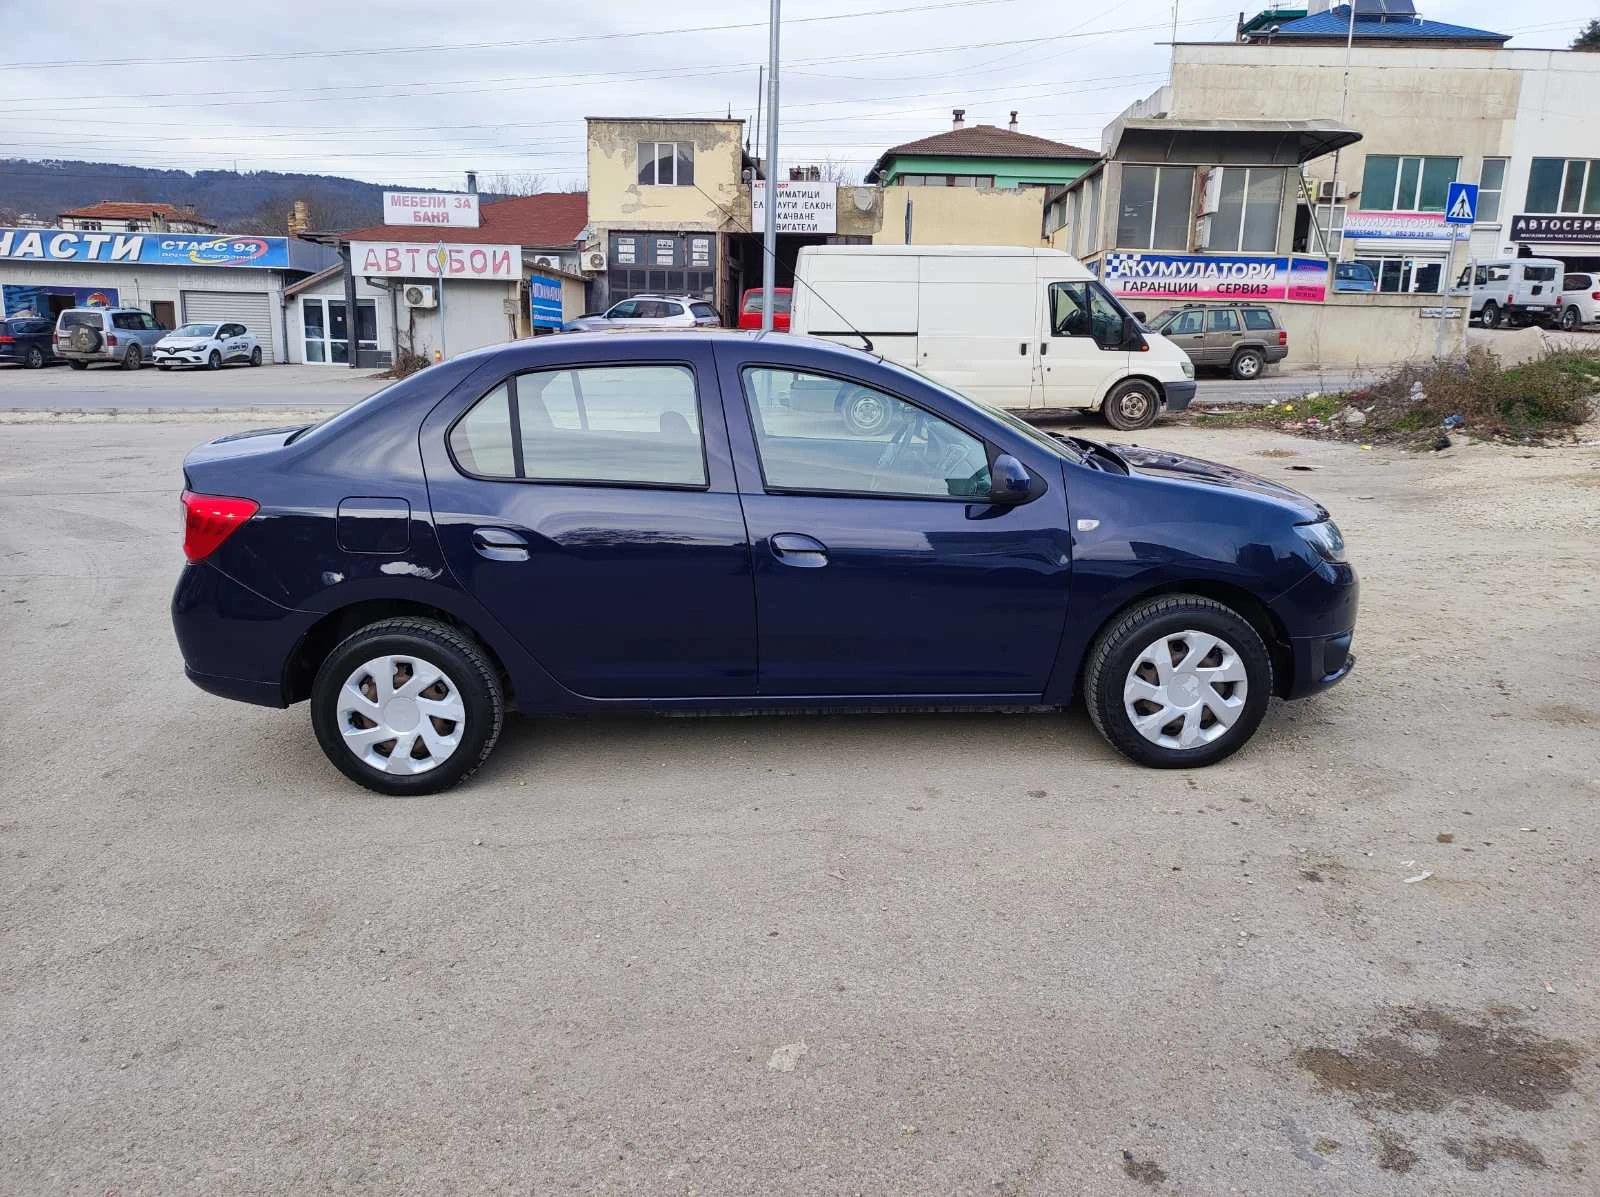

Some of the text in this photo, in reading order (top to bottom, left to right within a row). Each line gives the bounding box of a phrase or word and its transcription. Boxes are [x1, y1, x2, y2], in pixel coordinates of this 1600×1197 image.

[390, 194, 472, 209] МЕБЕЛИ ЗА
[776, 190, 820, 200] ИМАТИЦИ
[777, 201, 798, 209] ЛУГИ
[412, 210, 450, 223] БАНЯ
[776, 212, 815, 221] КАЧВАНЕ
[776, 223, 818, 232] ВИГАТЕЛИ
[161, 240, 257, 253] СТАРС 94
[363, 247, 511, 274] АВТОБОИ
[1117, 260, 1277, 280] АКУМУЛАТОРИ
[1123, 280, 1269, 295] ГАРАНЦИИ СЕРВИЗ
